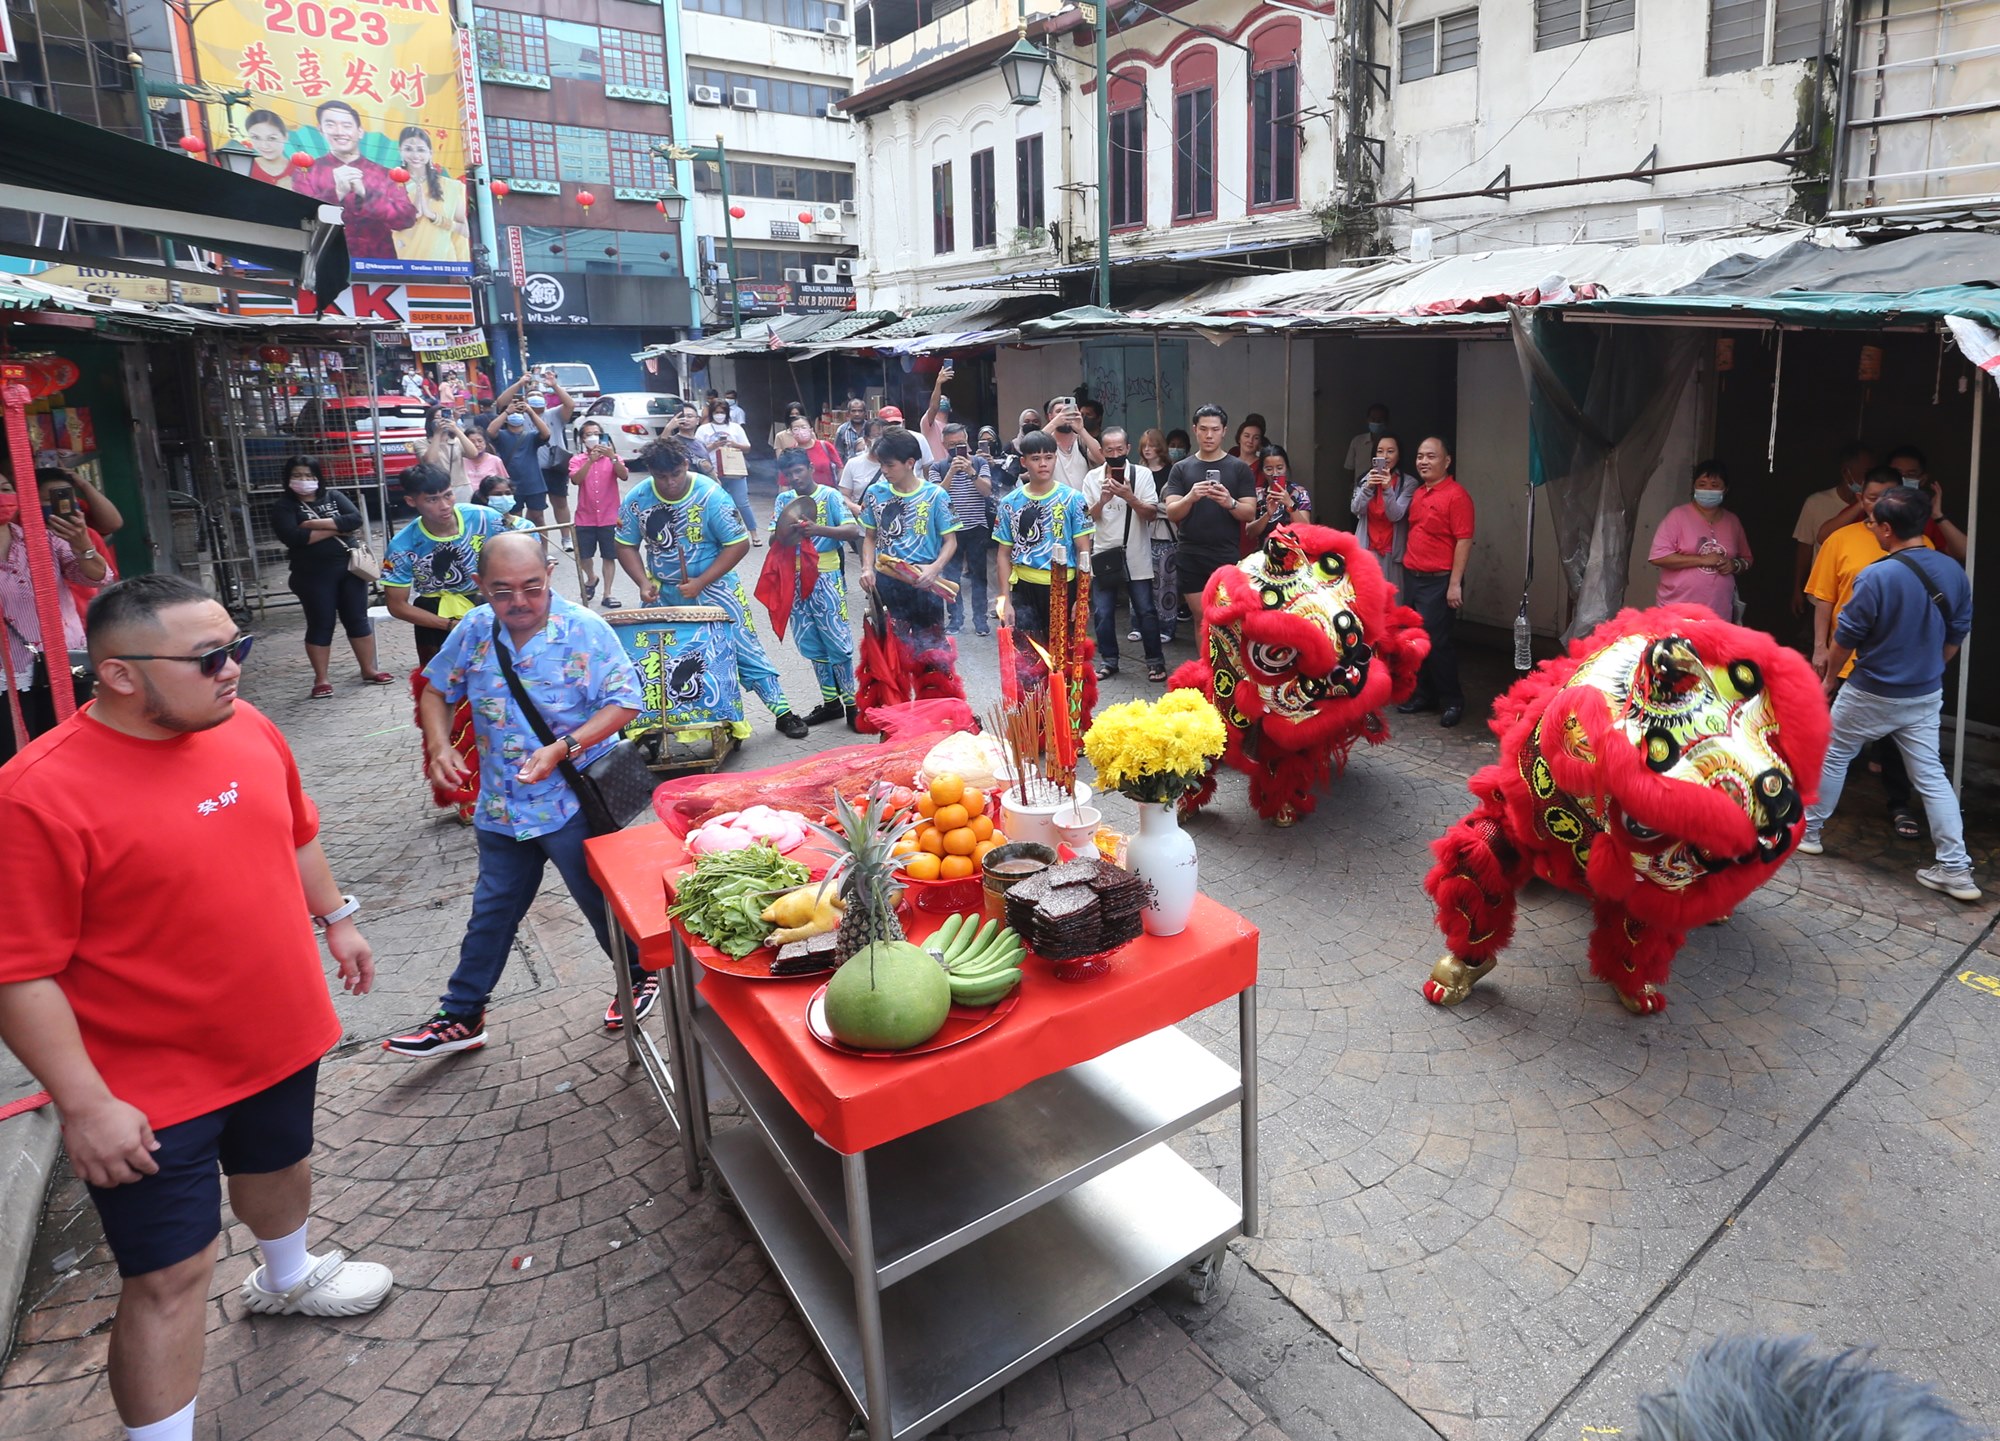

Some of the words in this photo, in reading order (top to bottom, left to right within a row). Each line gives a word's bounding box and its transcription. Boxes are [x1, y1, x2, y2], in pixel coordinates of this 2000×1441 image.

[264, 0, 389, 46] 2023
[460, 31, 469, 52] KK
[240, 42, 426, 108] 恭喜发财
[464, 58, 476, 113] SUPER
[470, 119, 480, 162] MART
[512, 239, 522, 264] SUPER
[515, 265, 523, 285] MART
[798, 295, 811, 306] SIX
[411, 313, 443, 321] SUPER
[445, 314, 470, 322] MART
[527, 313, 562, 323] Whale
[568, 315, 588, 323] Tea
[455, 333, 480, 346] RENT
[686, 504, 704, 543] 玄龍
[914, 501, 931, 535] 玄龍
